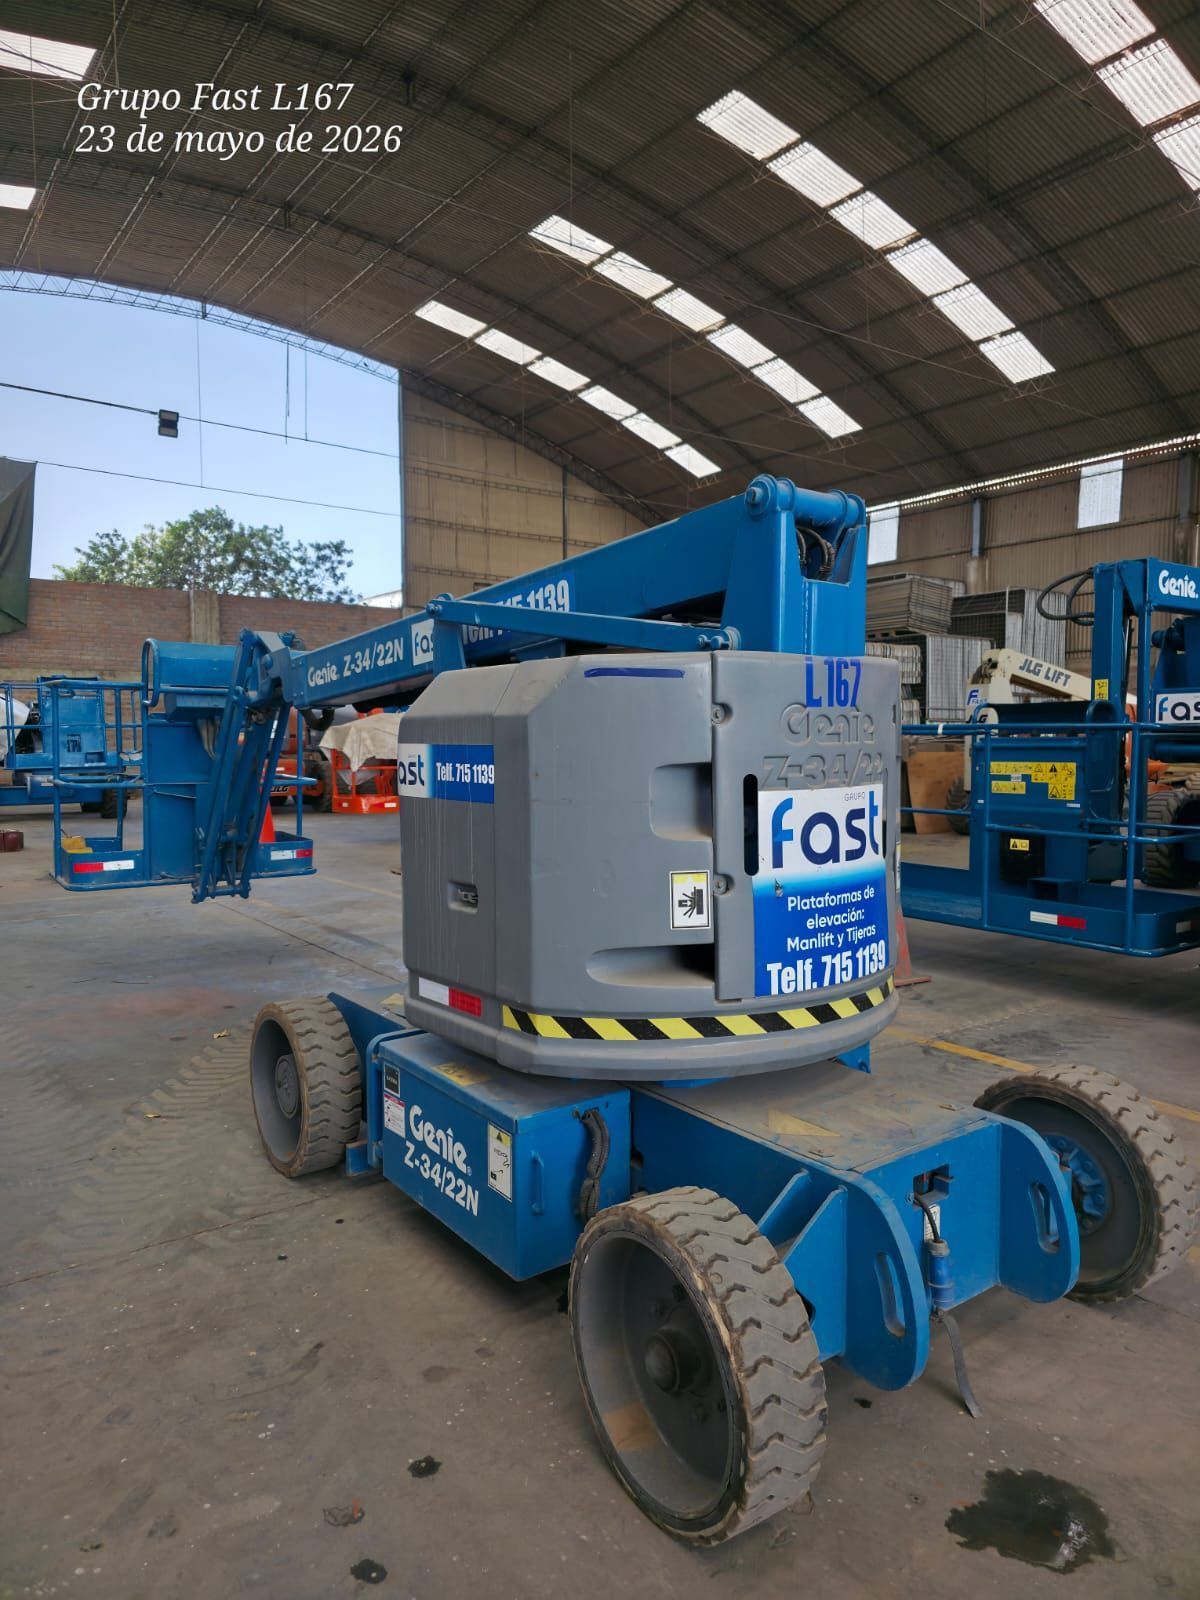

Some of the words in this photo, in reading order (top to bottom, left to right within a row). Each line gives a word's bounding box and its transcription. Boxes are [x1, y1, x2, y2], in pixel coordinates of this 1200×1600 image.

[343, 637, 404, 678] Z-34/22N
[1019, 658, 1043, 677] JLG
[1044, 664, 1072, 687] LIFT
[781, 702, 876, 747] Genie
[966, 714, 988, 724] JG
[436, 762, 455, 782] Telf.
[456, 763, 471, 783] 715
[472, 764, 495, 784] 1139
[844, 791, 865, 802] GRUPO
[772, 790, 879, 869] fast
[787, 890, 862, 912] Plataformas
[864, 885, 875, 899] de
[806, 907, 865, 930] elevación:
[787, 932, 835, 953] Manlift
[837, 932, 845, 948] y
[846, 924, 876, 944] Tijeras
[767, 958, 817, 996] Telf.
[821, 950, 853, 987] 715
[856, 940, 886, 977] 1139
[404, 1140, 479, 1217] Z-34/22N
